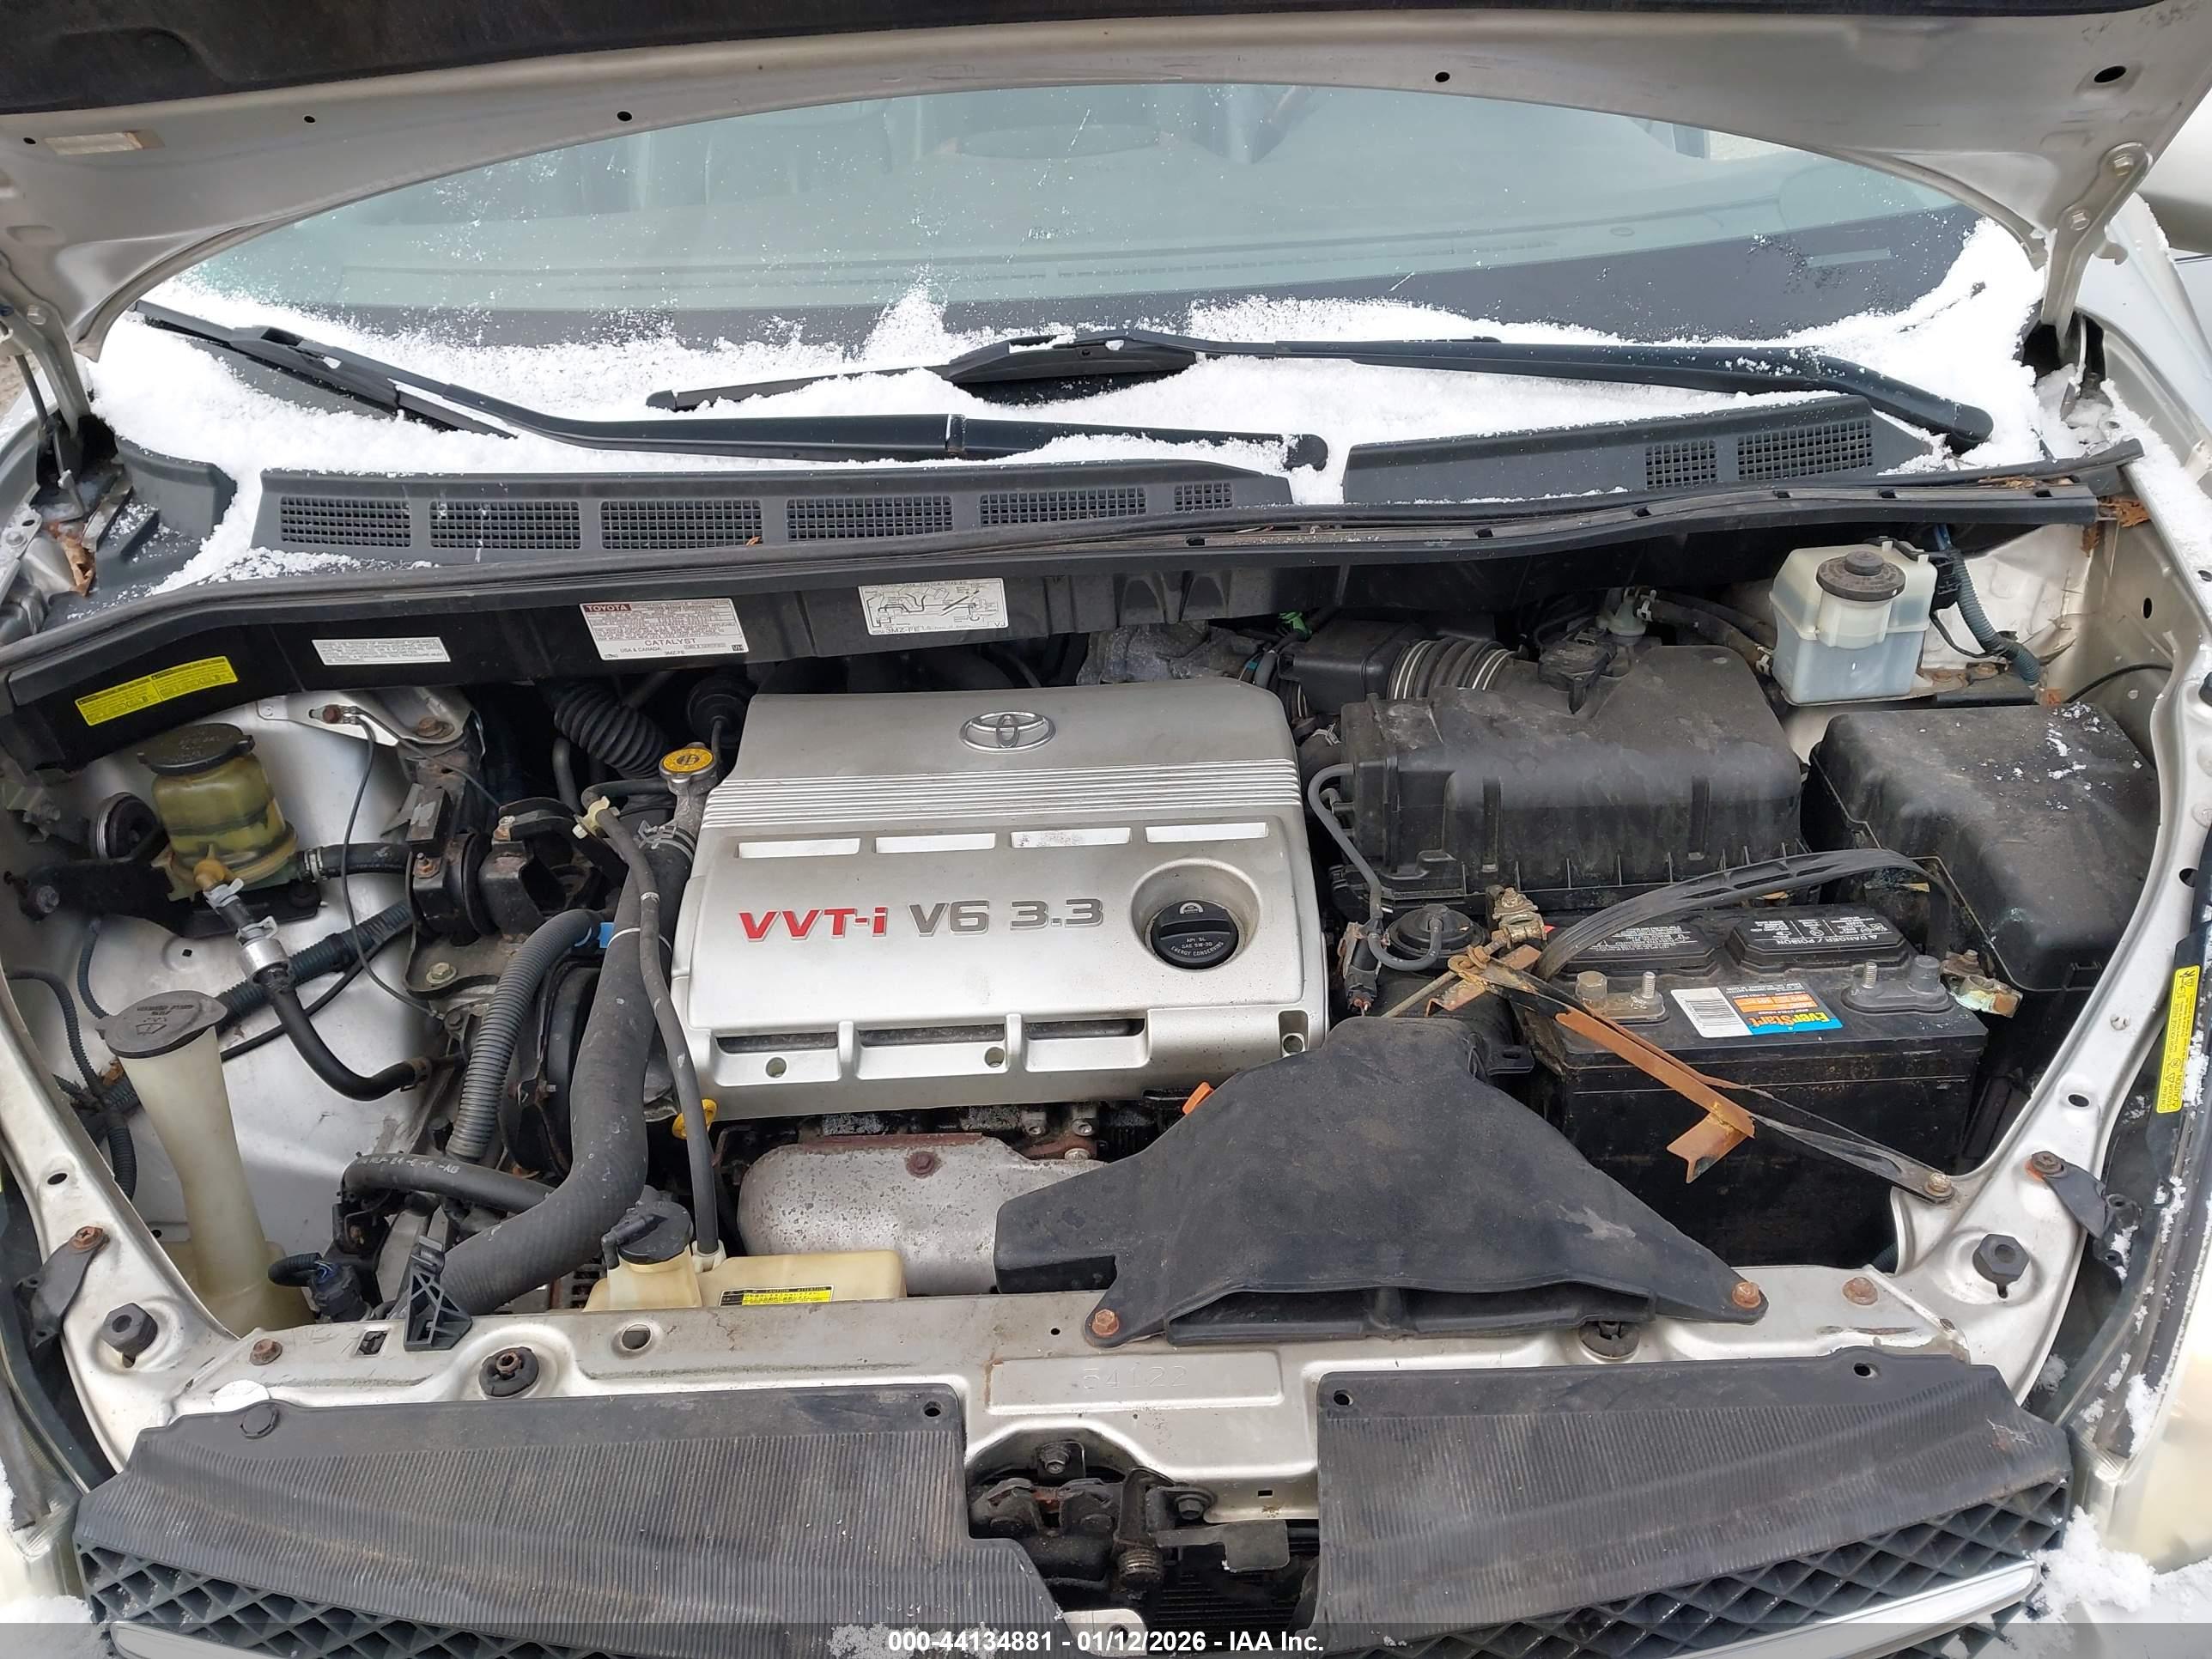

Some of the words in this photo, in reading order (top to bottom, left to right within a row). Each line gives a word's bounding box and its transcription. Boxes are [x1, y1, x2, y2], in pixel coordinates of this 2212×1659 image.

[585, 604, 629, 612] TOYOTA
[644, 638, 697, 647] CATALYST
[738, 906, 890, 943] VVT-i
[908, 899, 991, 937] V6
[1009, 897, 1105, 932] 3.3
[1170, 945, 1191, 956] ENERGY
[1193, 941, 1224, 957] CONSERVING
[1749, 1012, 1830, 1027] EverStart
[1083, 1365, 1189, 1389] 54122
